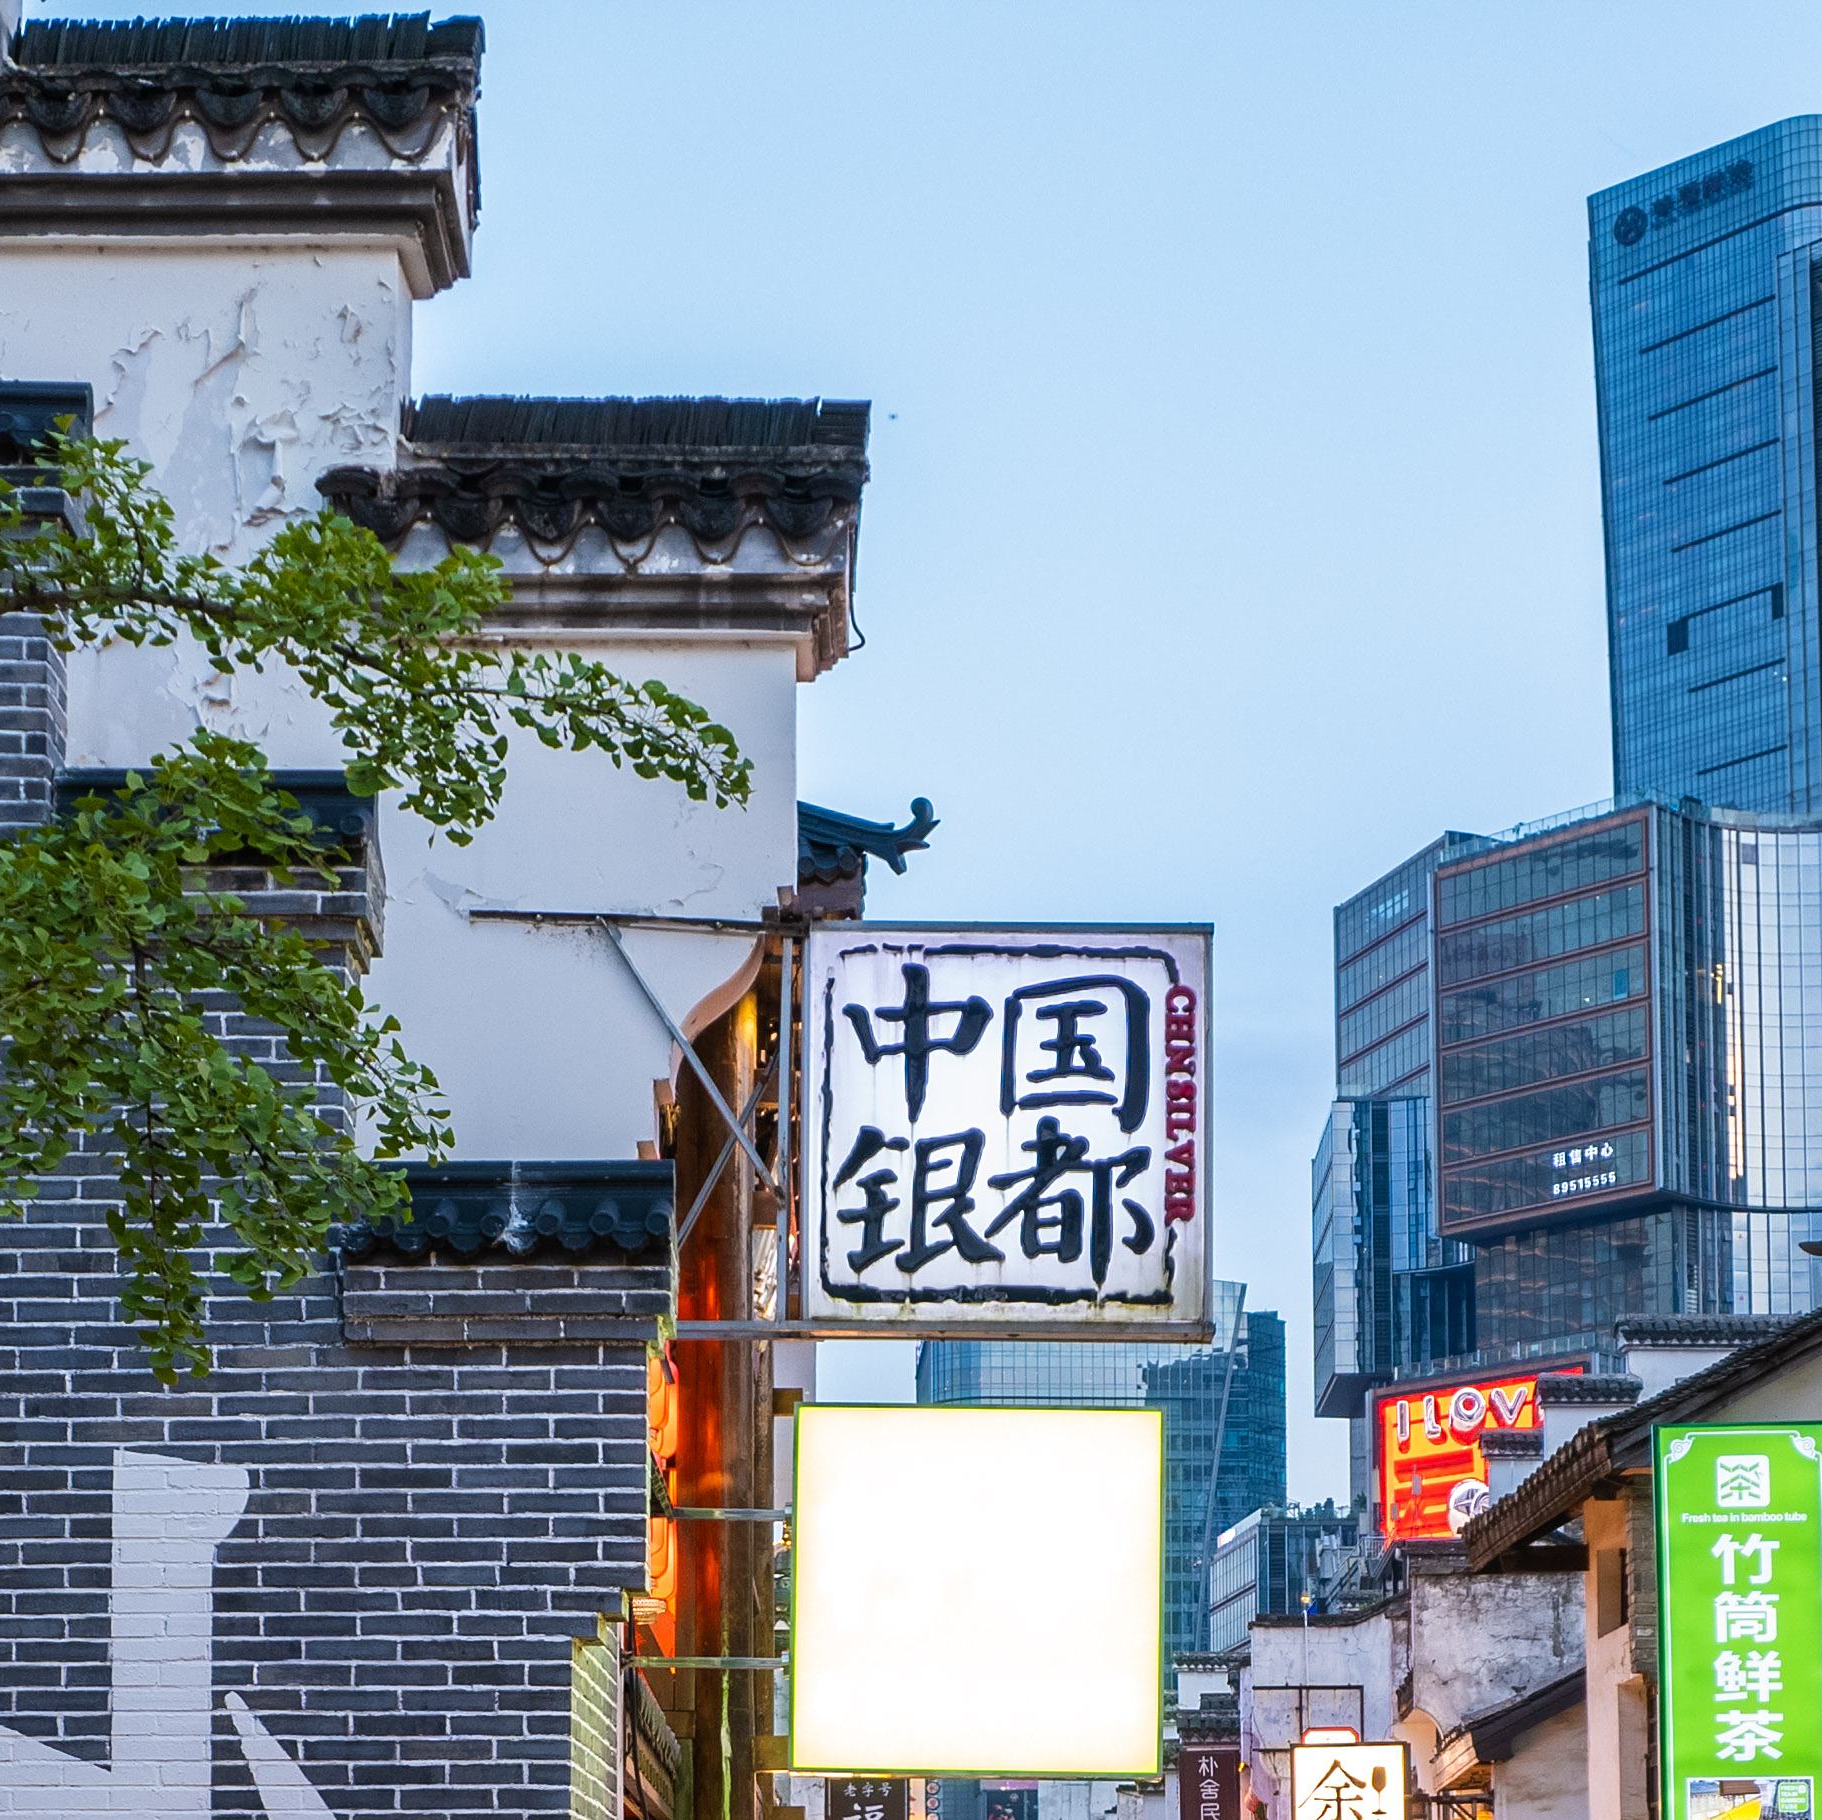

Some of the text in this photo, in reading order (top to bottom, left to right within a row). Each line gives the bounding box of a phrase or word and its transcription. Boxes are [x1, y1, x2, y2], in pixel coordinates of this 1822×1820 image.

[843, 962, 1150, 1134] 中国
[832, 1115, 1157, 1284] 银都
[1422, 1387, 1544, 1432] LOV
[1681, 1511, 1808, 1524] Fresh tea in bamboo tube
[1711, 1533, 1784, 1763] 竹筒鲜茶
[843, 1781, 893, 1798] 老字号
